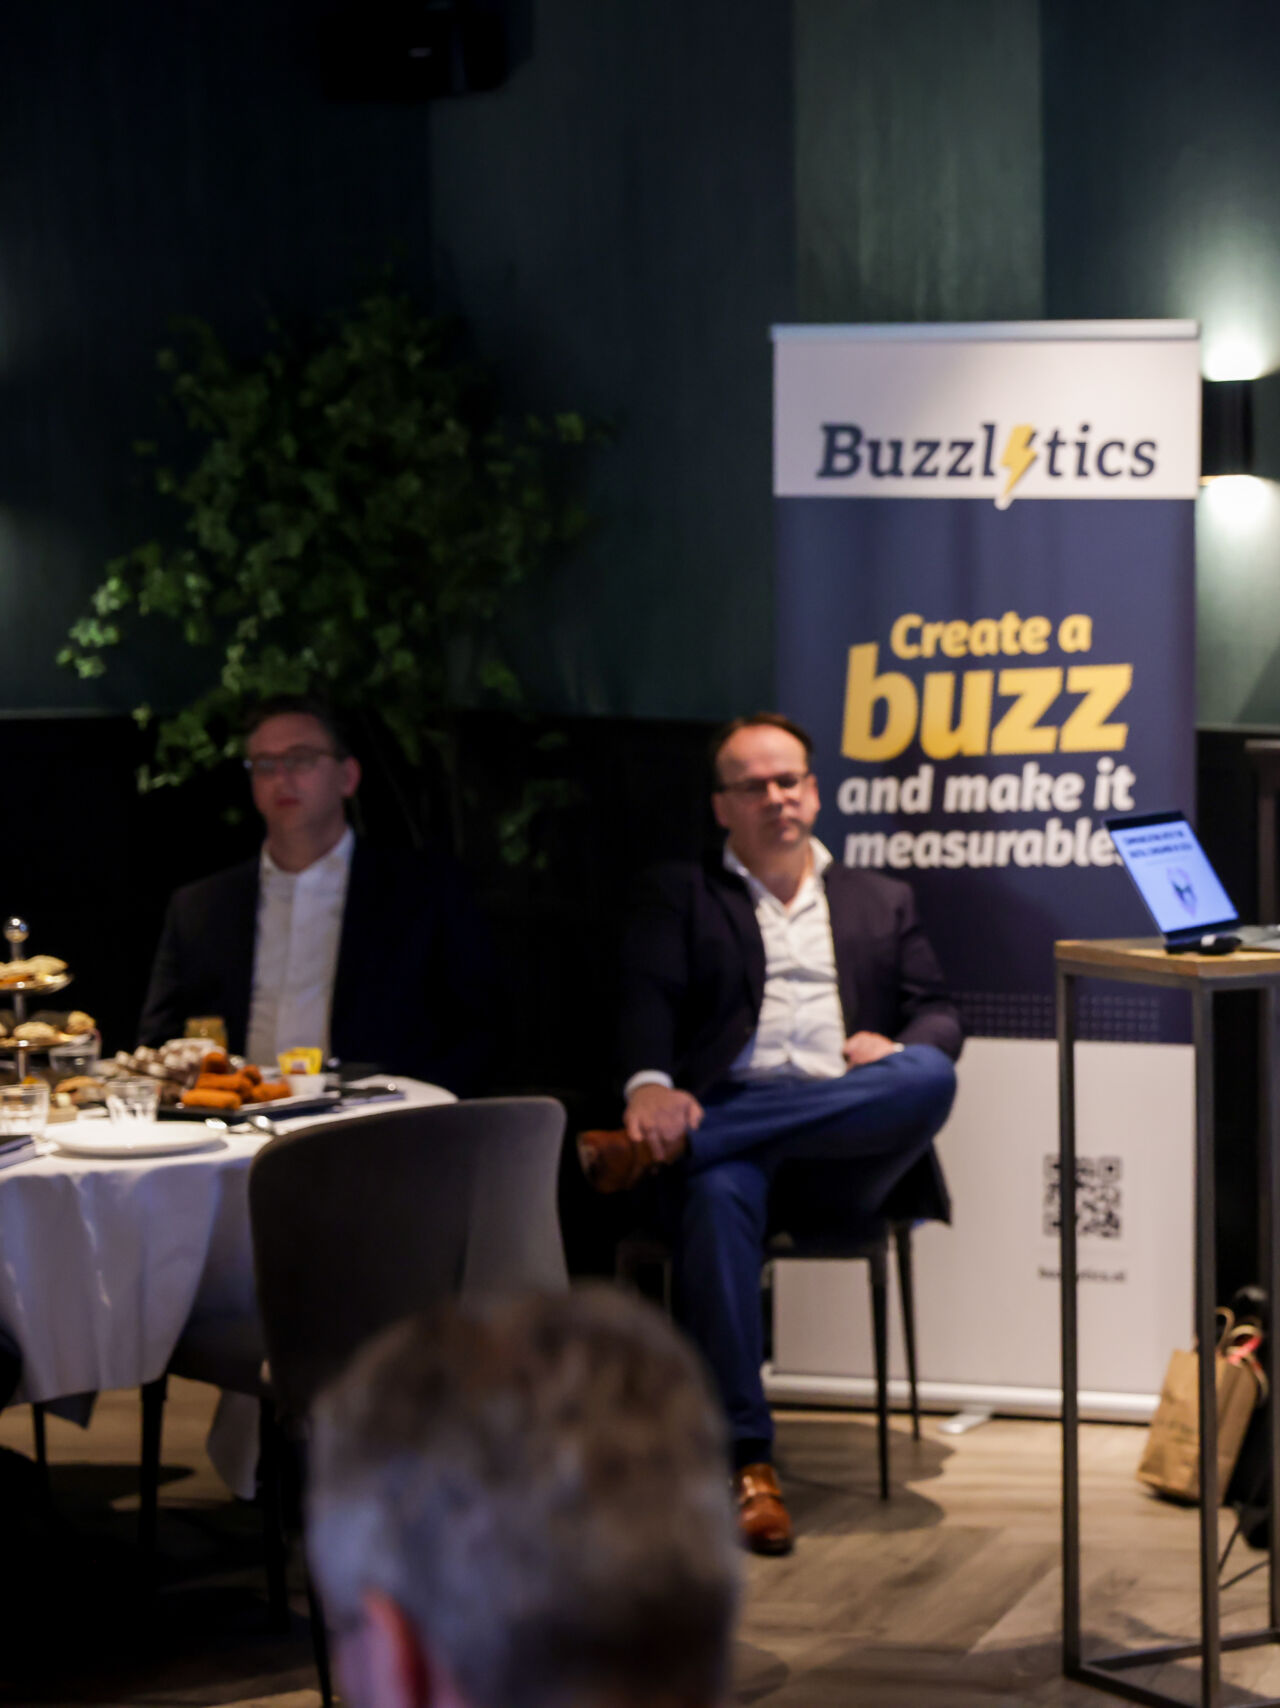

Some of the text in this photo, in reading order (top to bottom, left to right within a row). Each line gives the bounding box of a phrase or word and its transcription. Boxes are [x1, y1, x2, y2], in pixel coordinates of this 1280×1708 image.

[890, 611, 1093, 660] Create a
[840, 643, 1133, 762] buzz
[837, 756, 1136, 815] and make it
